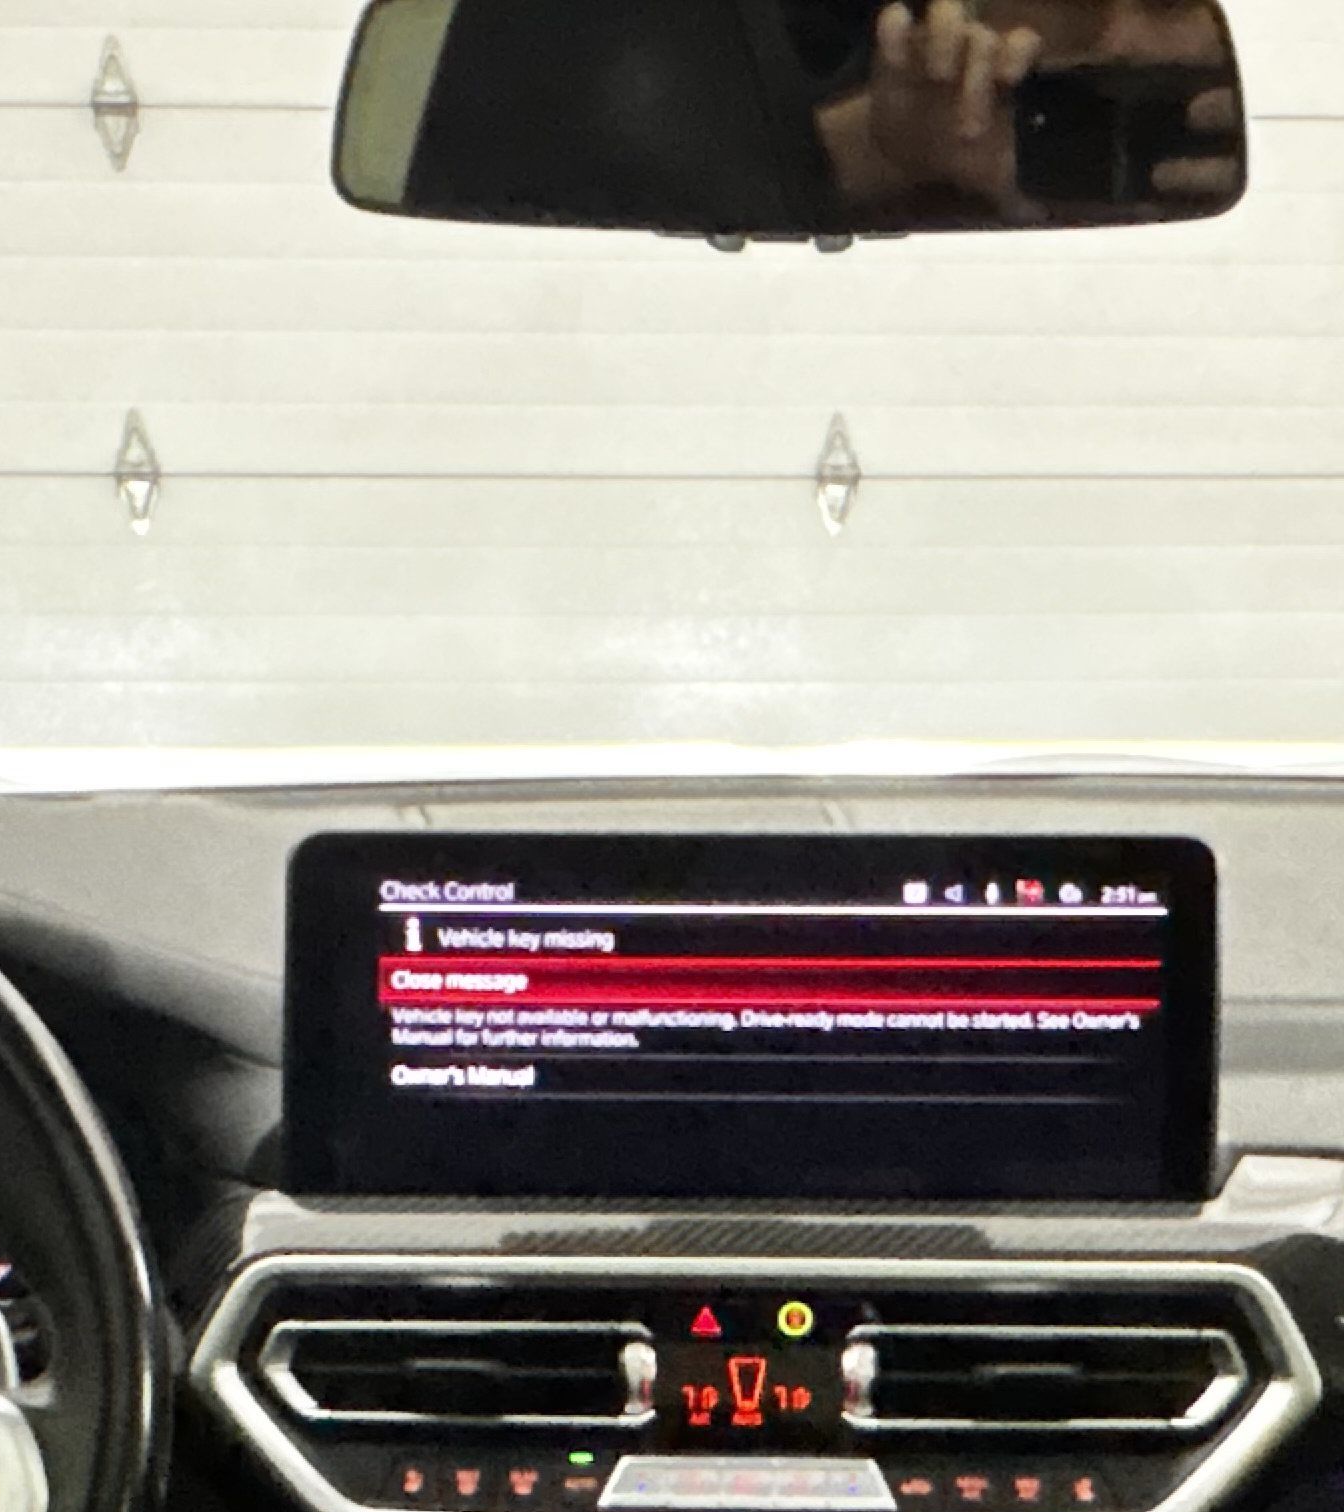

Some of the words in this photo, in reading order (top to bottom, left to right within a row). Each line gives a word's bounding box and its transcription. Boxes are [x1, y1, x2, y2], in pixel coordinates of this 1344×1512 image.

[379, 881, 439, 901] Check
[444, 881, 515, 901] Control
[437, 928, 505, 949] Vehicle
[507, 928, 542, 951] key
[544, 928, 616, 952] missing
[391, 970, 443, 991] Close
[444, 973, 529, 994] message
[391, 1007, 453, 1025] Vehicle
[485, 1008, 515, 1026] not
[516, 1008, 589, 1026] available
[391, 1027, 453, 1046] Manual
[455, 1028, 479, 1046] for
[482, 1028, 539, 1048] further
[391, 1065, 466, 1086] Owner's
[466, 1065, 536, 1088] Manual
